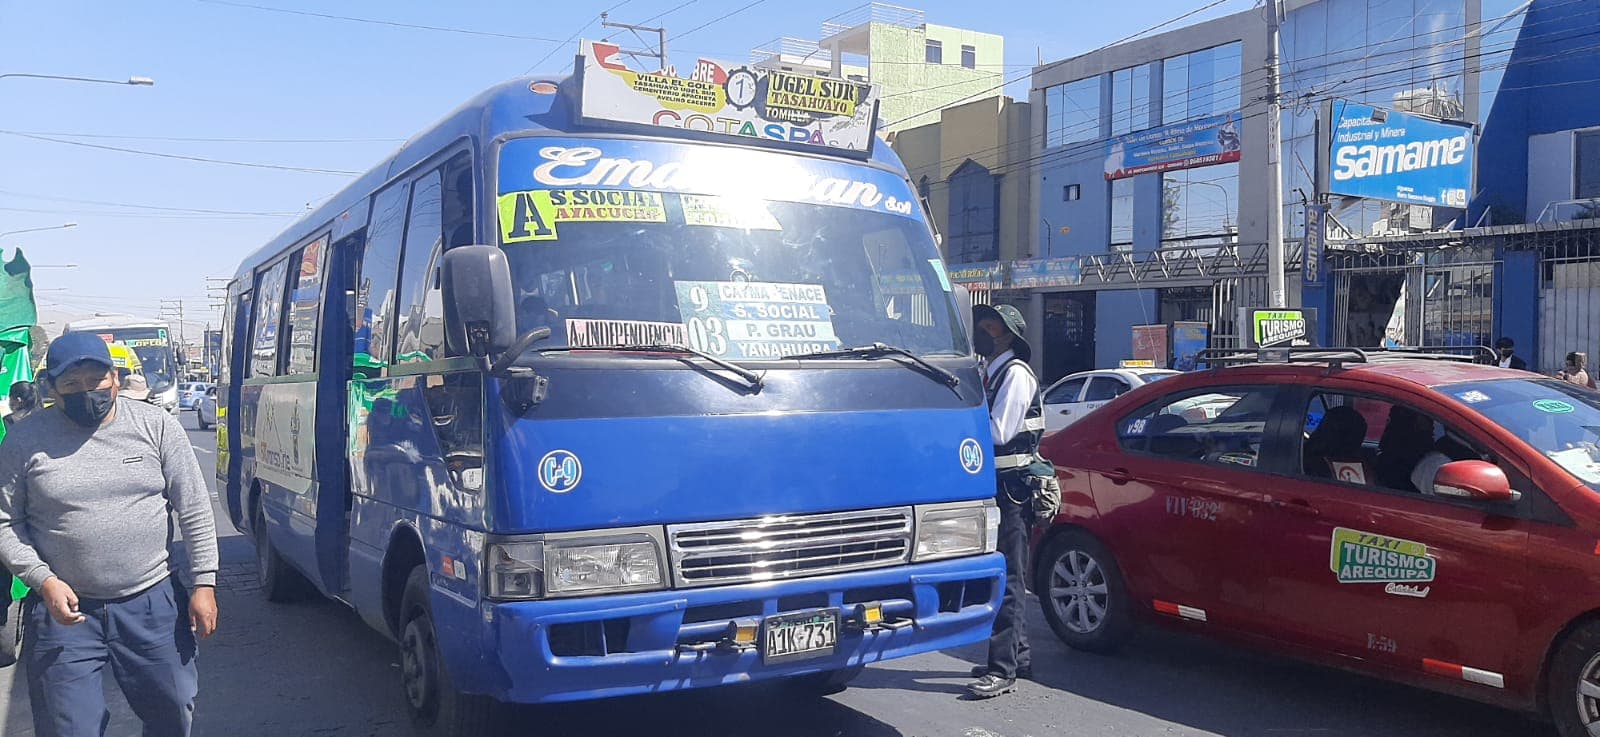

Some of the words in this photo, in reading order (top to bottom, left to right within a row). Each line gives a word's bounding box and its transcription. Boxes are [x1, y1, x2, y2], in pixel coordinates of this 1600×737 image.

[637, 74, 668, 85] VILLA
[671, 78, 685, 88] EL
[687, 81, 715, 91] GOLF
[772, 71, 816, 97] UGEL
[820, 78, 855, 103] SUR
[771, 91, 847, 113] TASAHUAYO
[1337, 129, 1374, 144] Industrial
[1381, 127, 1406, 139] Minera
[508, 193, 553, 239] A
[690, 286, 709, 312] 9
[735, 304, 751, 319] S.
[758, 305, 820, 320] SOCIAL
[687, 316, 727, 356] 03
[745, 324, 760, 338] P.
[766, 324, 816, 338] GRAU
[1260, 319, 1304, 339] TURISMO
[1262, 328, 1304, 345] AREQUIPA
[963, 445, 980, 468] 94
[544, 456, 578, 487] C-9
[1358, 534, 1401, 549] TAXI
[1344, 542, 1429, 570] TURISMO
[1340, 564, 1429, 579] AREQUIPA
[767, 621, 836, 656] A1K-731
